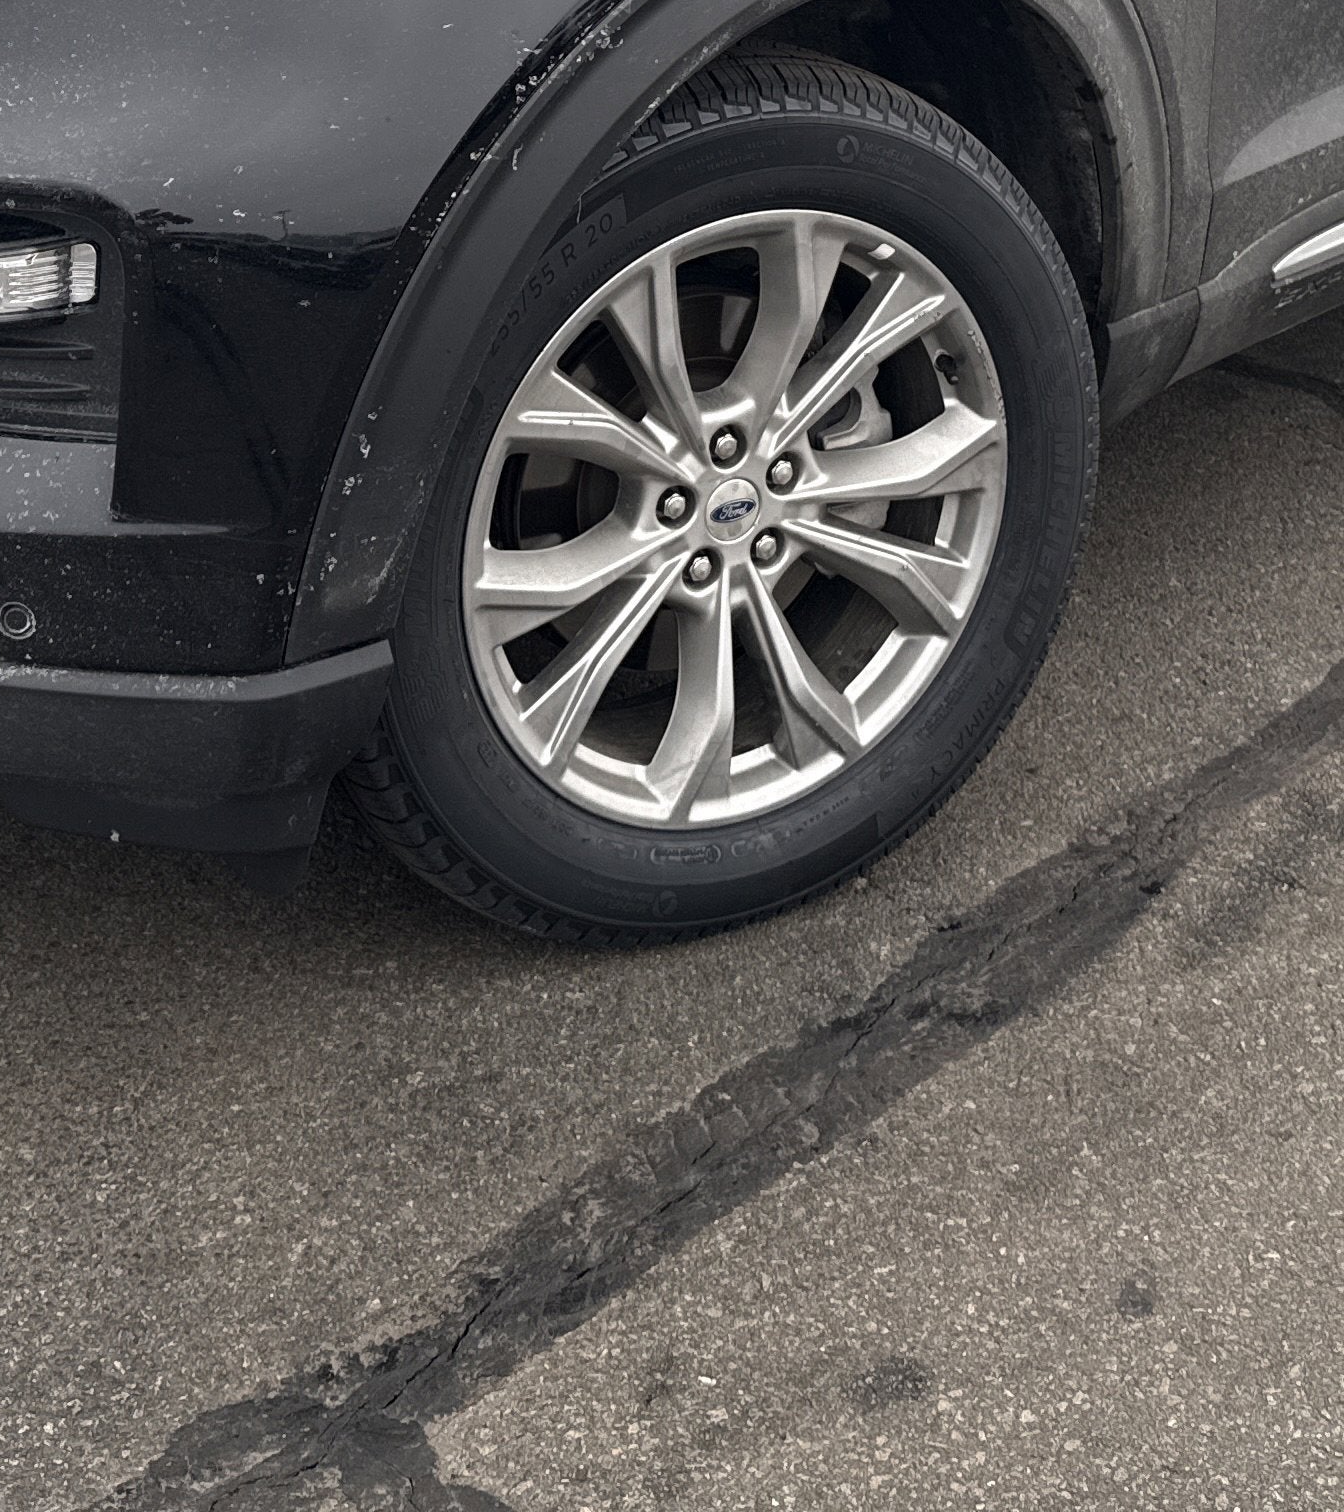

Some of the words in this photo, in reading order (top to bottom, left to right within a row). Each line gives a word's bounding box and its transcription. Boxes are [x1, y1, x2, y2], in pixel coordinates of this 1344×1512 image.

[862, 141, 914, 166] MICHELIN
[561, 243, 577, 267] R
[585, 212, 613, 248] 20
[720, 502, 747, 519] Ford
[928, 677, 1005, 785] PRIMACY
